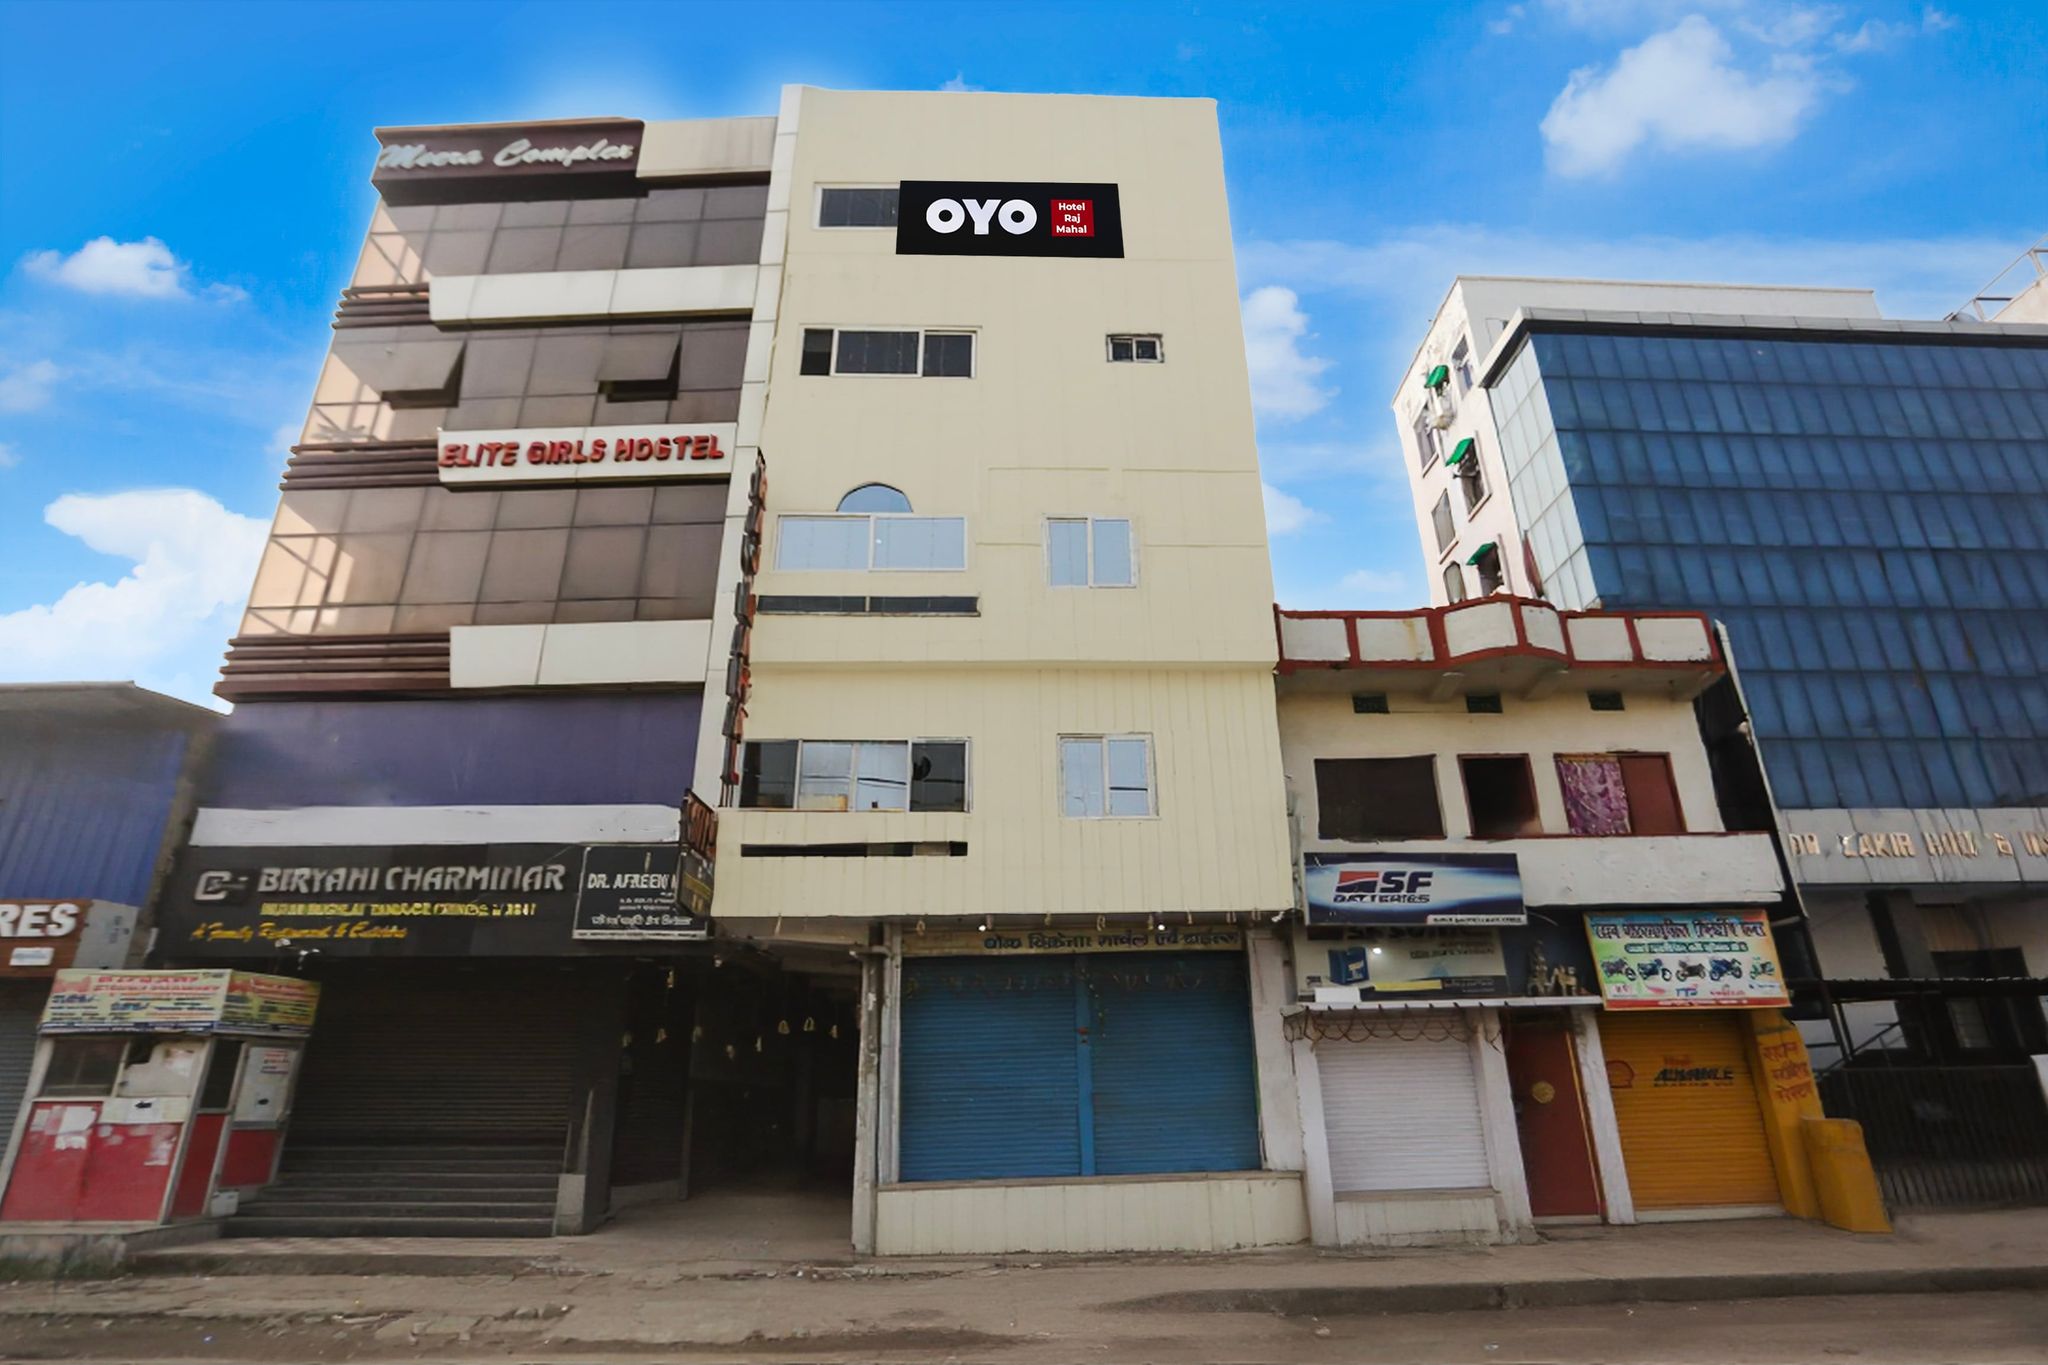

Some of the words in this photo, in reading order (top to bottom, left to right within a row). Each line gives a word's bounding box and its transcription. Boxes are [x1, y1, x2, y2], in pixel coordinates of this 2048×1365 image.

[926, 198, 1037, 235] OYO
[1058, 202, 1086, 211] Hotel
[1064, 213, 1080, 223] Raj
[1056, 225, 1087, 234] Mahal
[438, 442, 520, 467] ELITE
[527, 439, 607, 465] GIRLS
[614, 434, 725, 461] HOSTEL
[257, 867, 379, 893] BIRYANI
[385, 864, 566, 891] CHARMINAR
[1379, 871, 1434, 893] SF
[0, 903, 79, 937] RES
